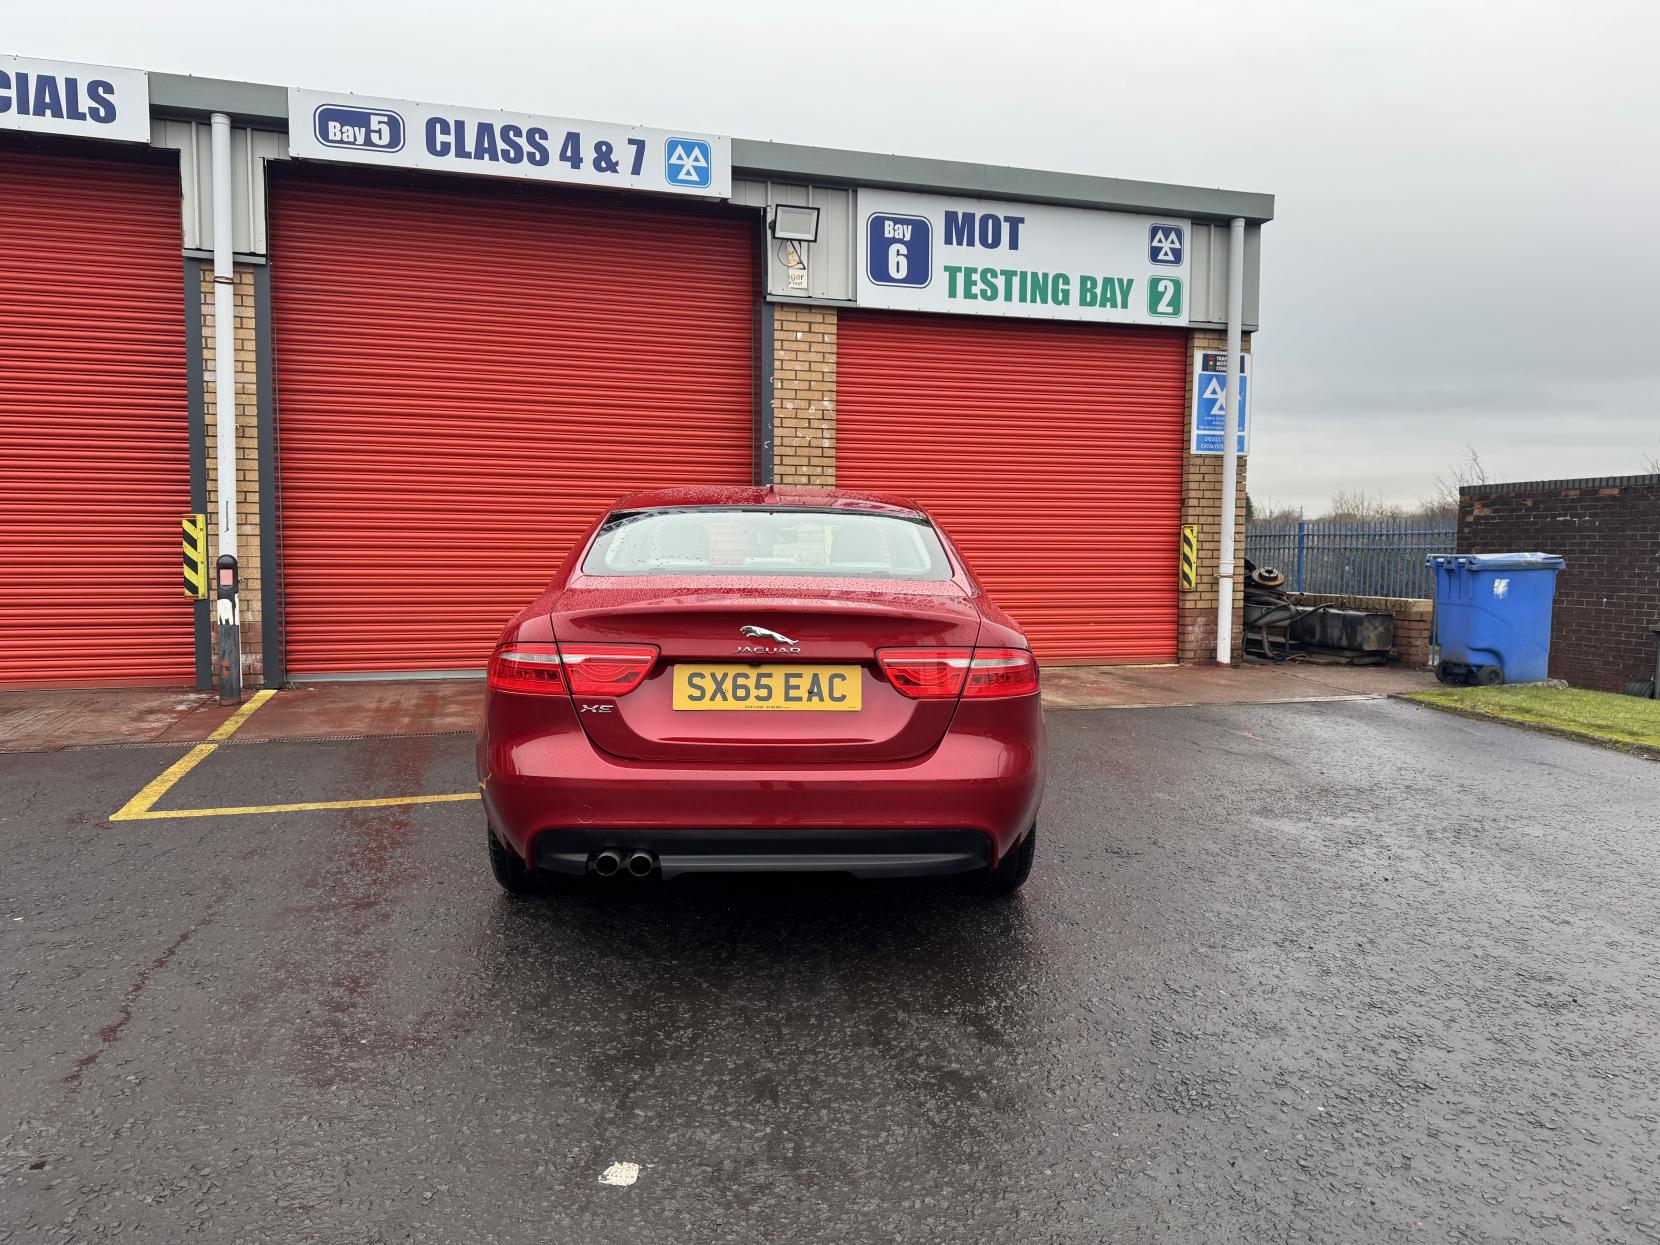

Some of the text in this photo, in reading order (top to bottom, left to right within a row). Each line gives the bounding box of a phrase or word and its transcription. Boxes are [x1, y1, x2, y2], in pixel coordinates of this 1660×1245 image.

[328, 114, 391, 146] Bay 5
[425, 116, 647, 176] CLASS 4 & 7
[884, 220, 912, 241] Bay
[944, 210, 1026, 251] MOT
[888, 243, 909, 280] 6
[943, 265, 1175, 314] TESTING BAY 2
[734, 646, 801, 655] JAGUAR
[687, 672, 848, 703] SX65 EAC
[580, 704, 614, 713] XE
